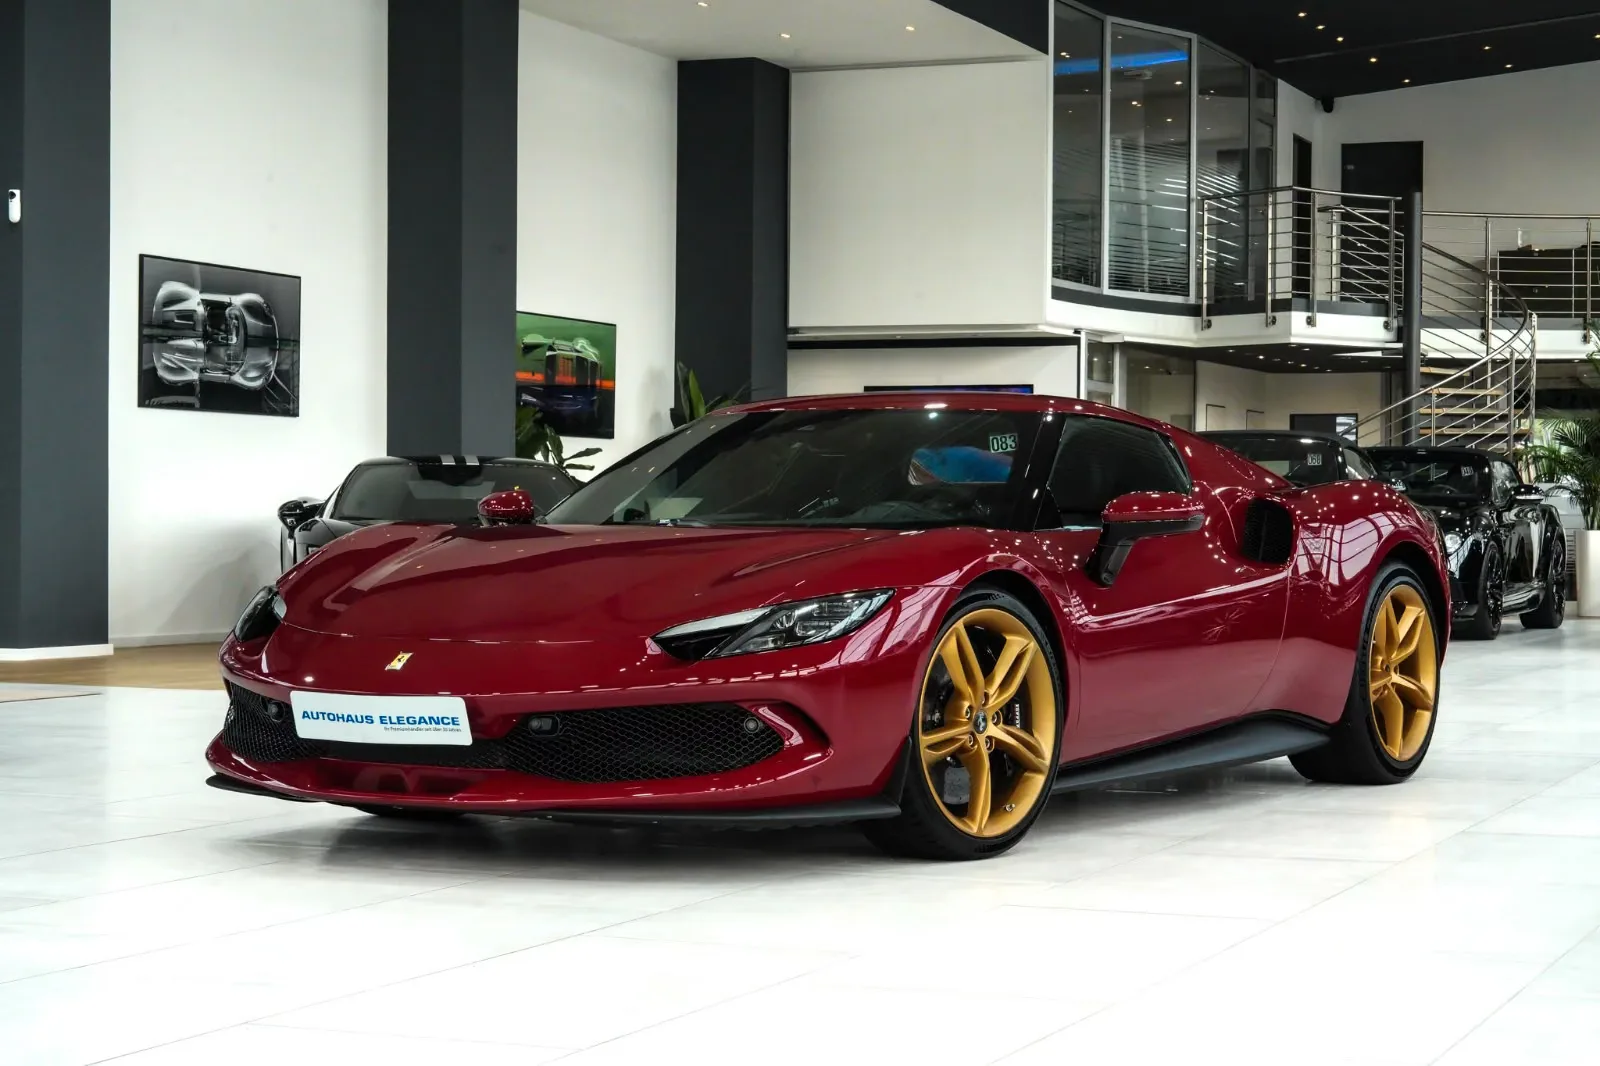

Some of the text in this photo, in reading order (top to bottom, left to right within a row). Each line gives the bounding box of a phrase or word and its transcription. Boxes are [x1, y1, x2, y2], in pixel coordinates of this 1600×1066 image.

[991, 435, 1017, 451] 083
[302, 710, 460, 726] AUTOHAUS ELEGANCE
